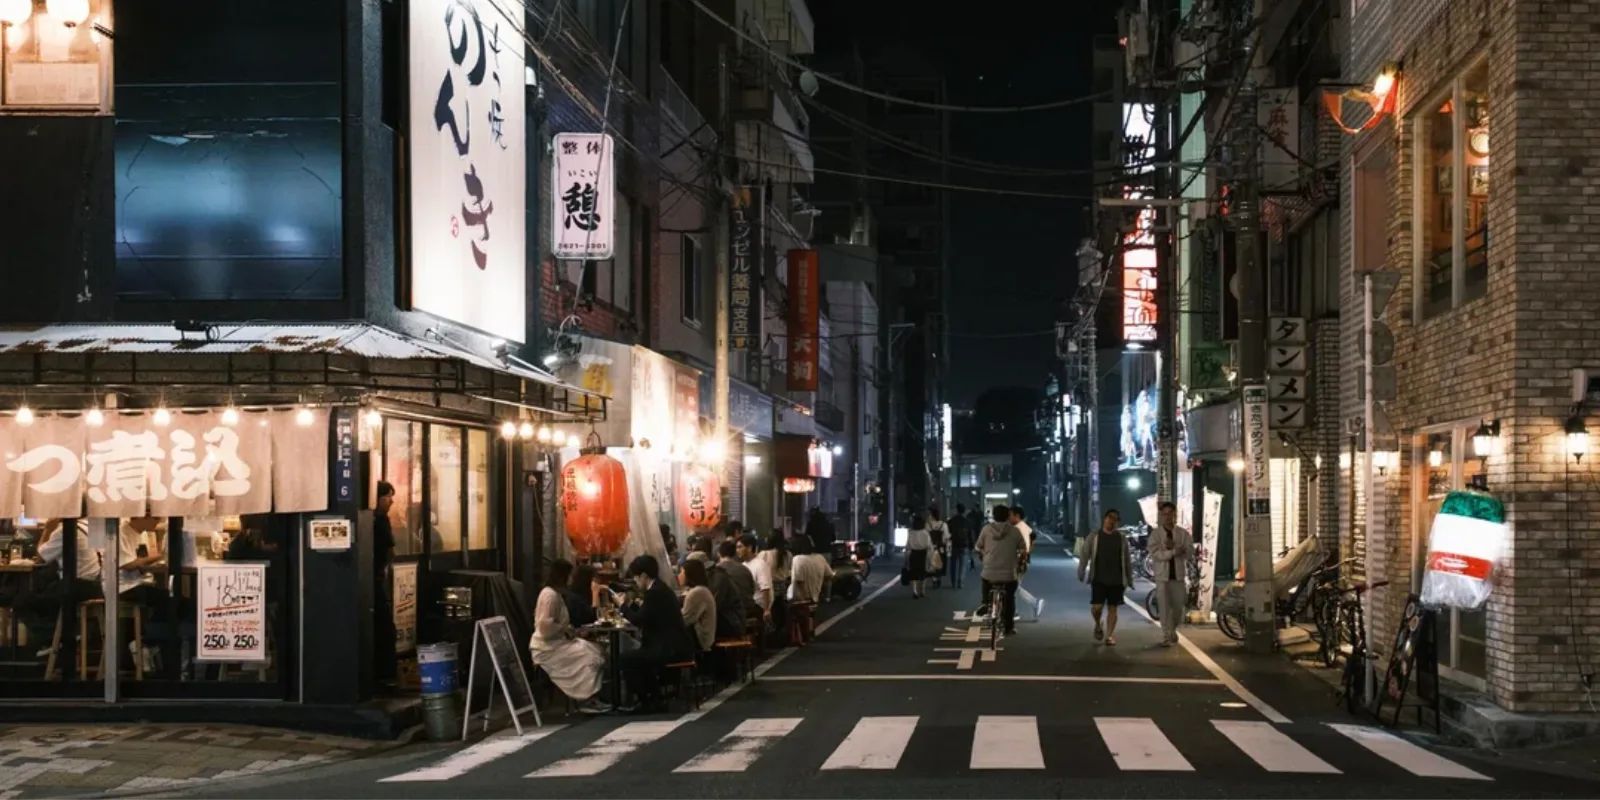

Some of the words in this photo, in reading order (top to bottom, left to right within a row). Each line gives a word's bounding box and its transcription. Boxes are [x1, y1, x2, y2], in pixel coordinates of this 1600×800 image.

[562, 141, 602, 155] 整体
[562, 182, 601, 231] 憩
[1275, 320, 1301, 424] タンメン
[6, 426, 251, 503] つ煮込
